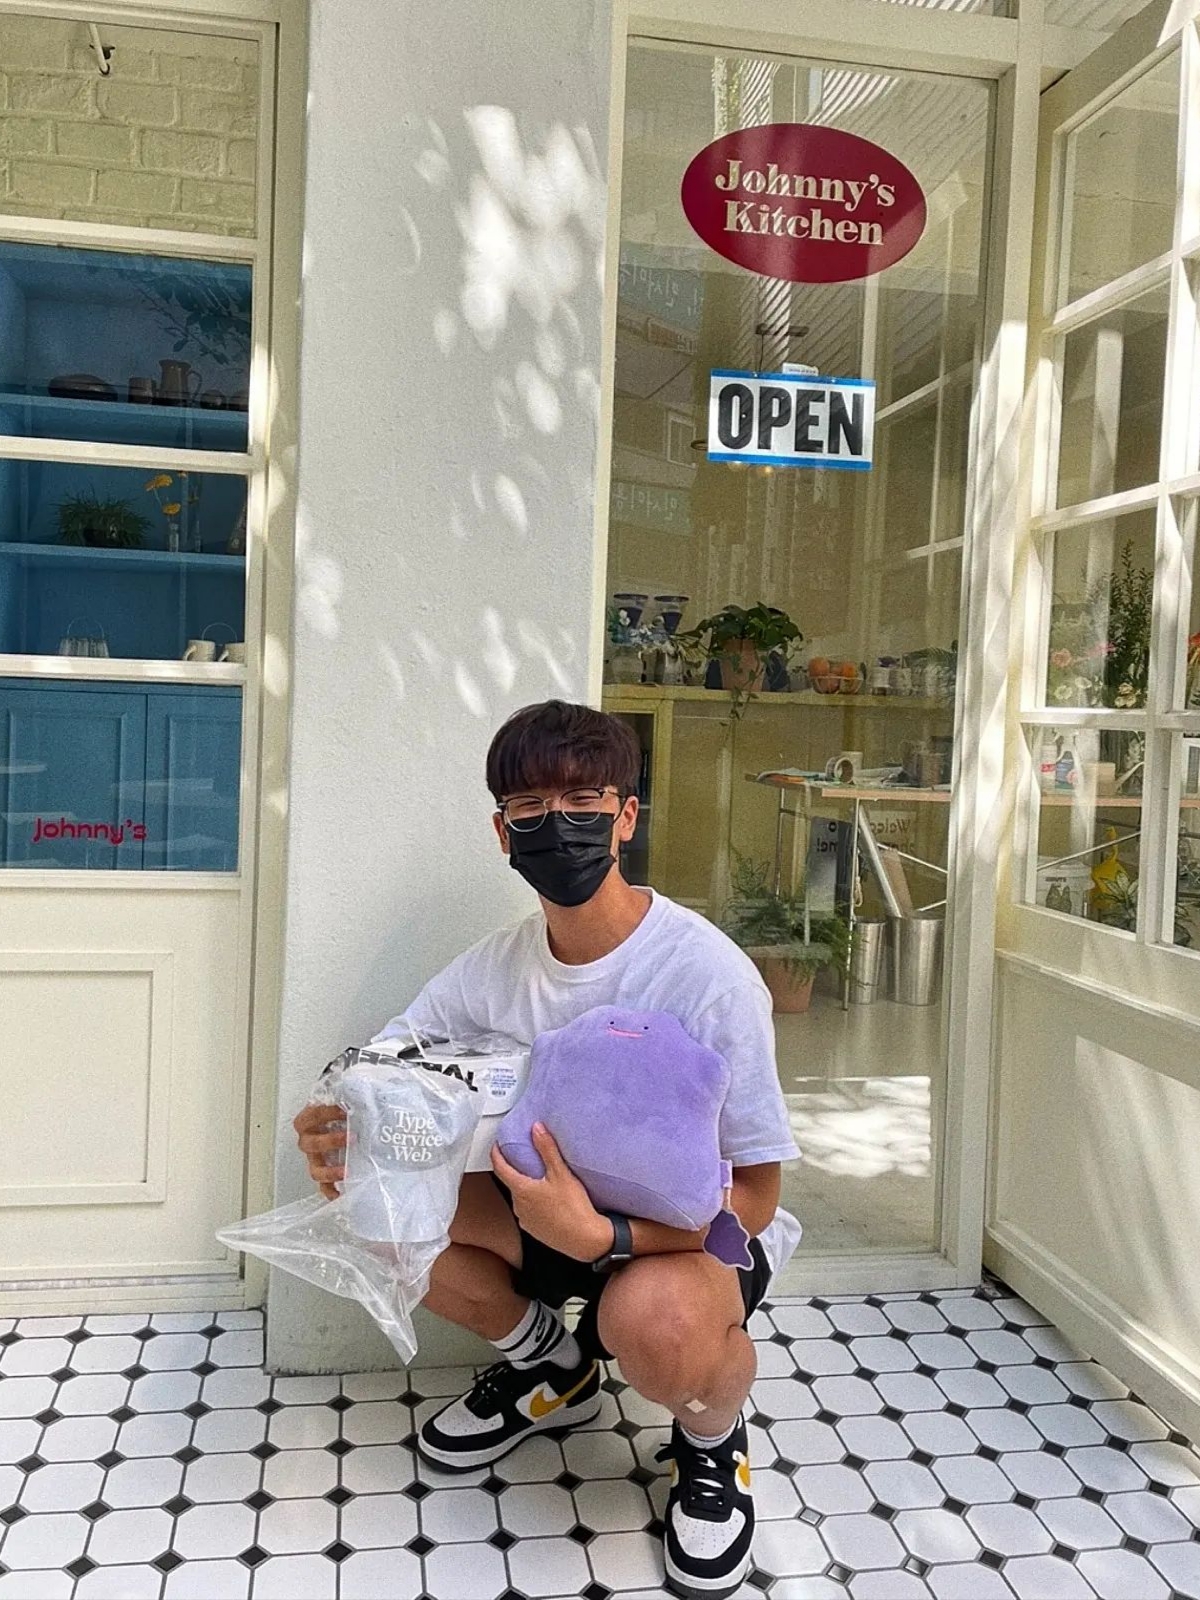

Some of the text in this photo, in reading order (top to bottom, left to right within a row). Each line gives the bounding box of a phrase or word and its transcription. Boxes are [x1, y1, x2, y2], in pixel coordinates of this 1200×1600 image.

[715, 159, 896, 212] Johnny's
[723, 199, 885, 246] Kitchen
[718, 383, 865, 456] OPEN
[33, 816, 147, 845] Johnny's
[380, 1126, 444, 1147] Service
[394, 1110, 436, 1134] Type
